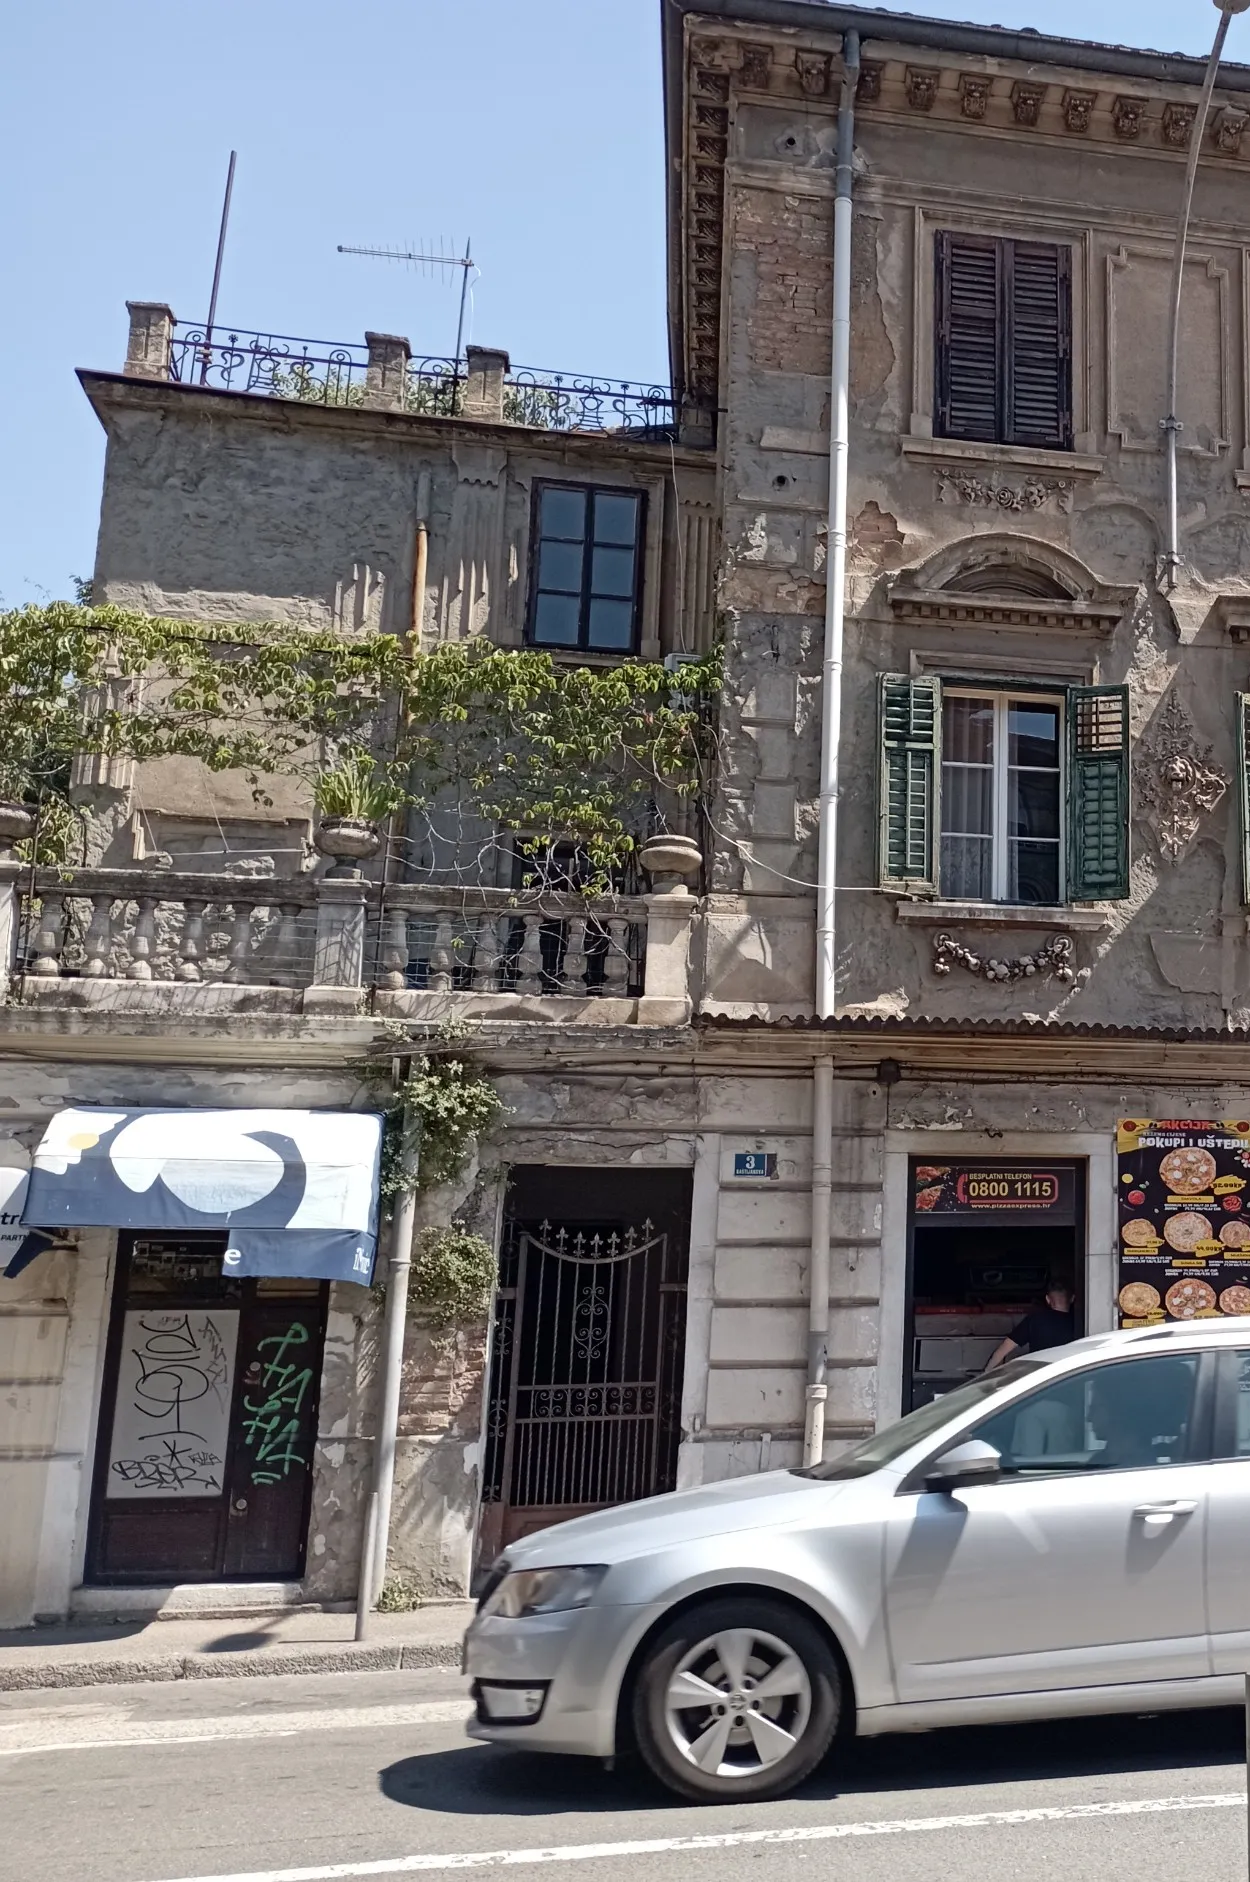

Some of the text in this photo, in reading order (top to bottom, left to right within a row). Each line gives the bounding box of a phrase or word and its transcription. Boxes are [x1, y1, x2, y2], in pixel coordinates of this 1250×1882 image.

[1161, 1120, 1211, 1130] AKCIJA
[1138, 1137, 1185, 1148] POKUPI
[745, 1155, 756, 1169] 3
[969, 1181, 1052, 1197] 0800 1115
